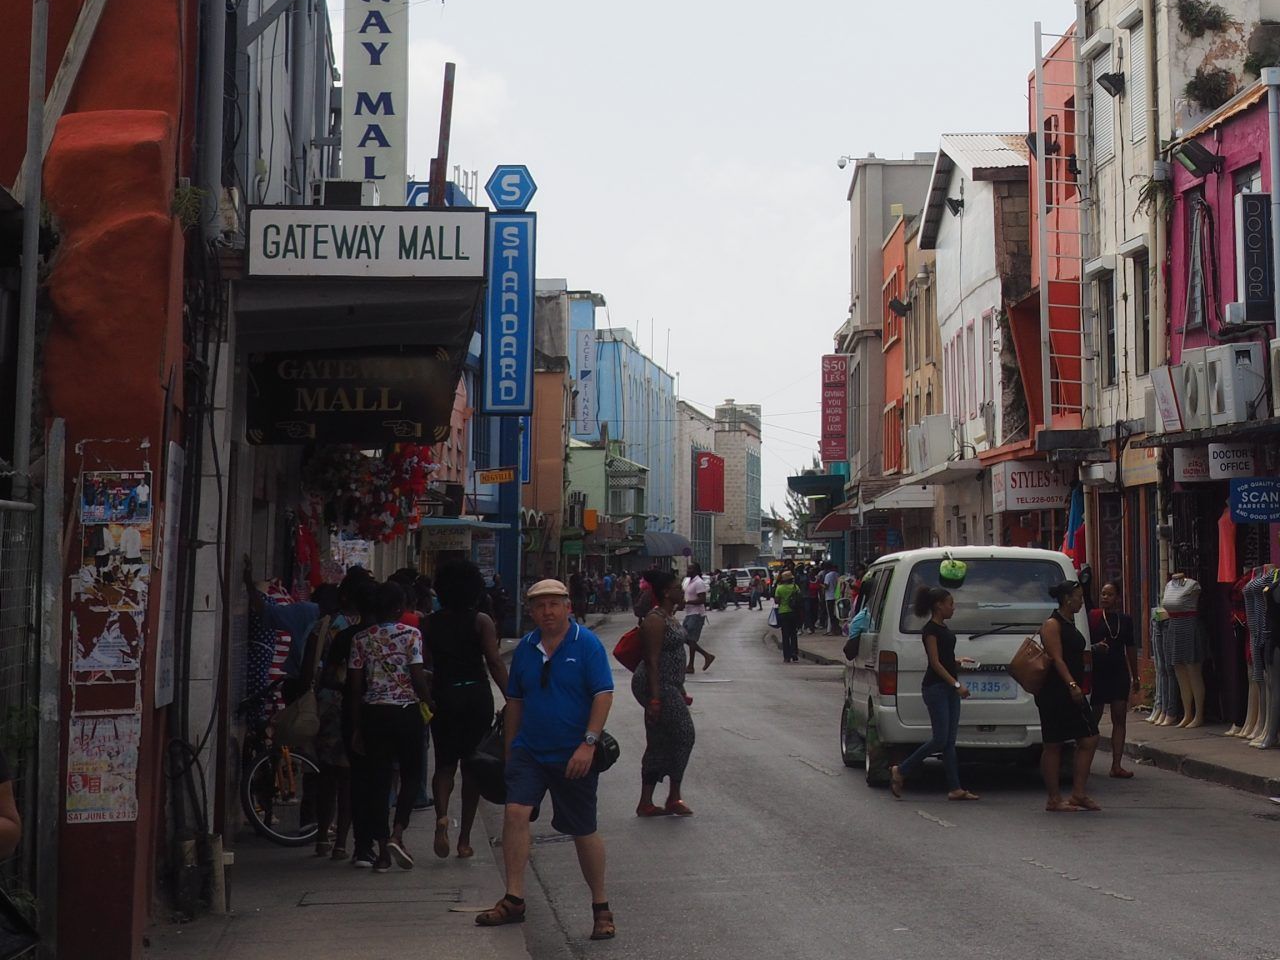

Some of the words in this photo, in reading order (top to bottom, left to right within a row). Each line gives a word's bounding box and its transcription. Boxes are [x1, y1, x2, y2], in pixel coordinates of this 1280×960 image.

[354, 91, 395, 180] MAL
[501, 174, 521, 201] S
[262, 223, 386, 260] GATEWAY
[398, 225, 470, 261] MALL
[1246, 200, 1264, 297] DOCTOR
[499, 226, 519, 401] STANDARD
[823, 359, 846, 372] $50
[294, 386, 402, 412] MALL
[1010, 470, 1051, 489] STYLES
[1220, 461, 1250, 472] OFFICE
[86, 812, 106, 820] JUNE
